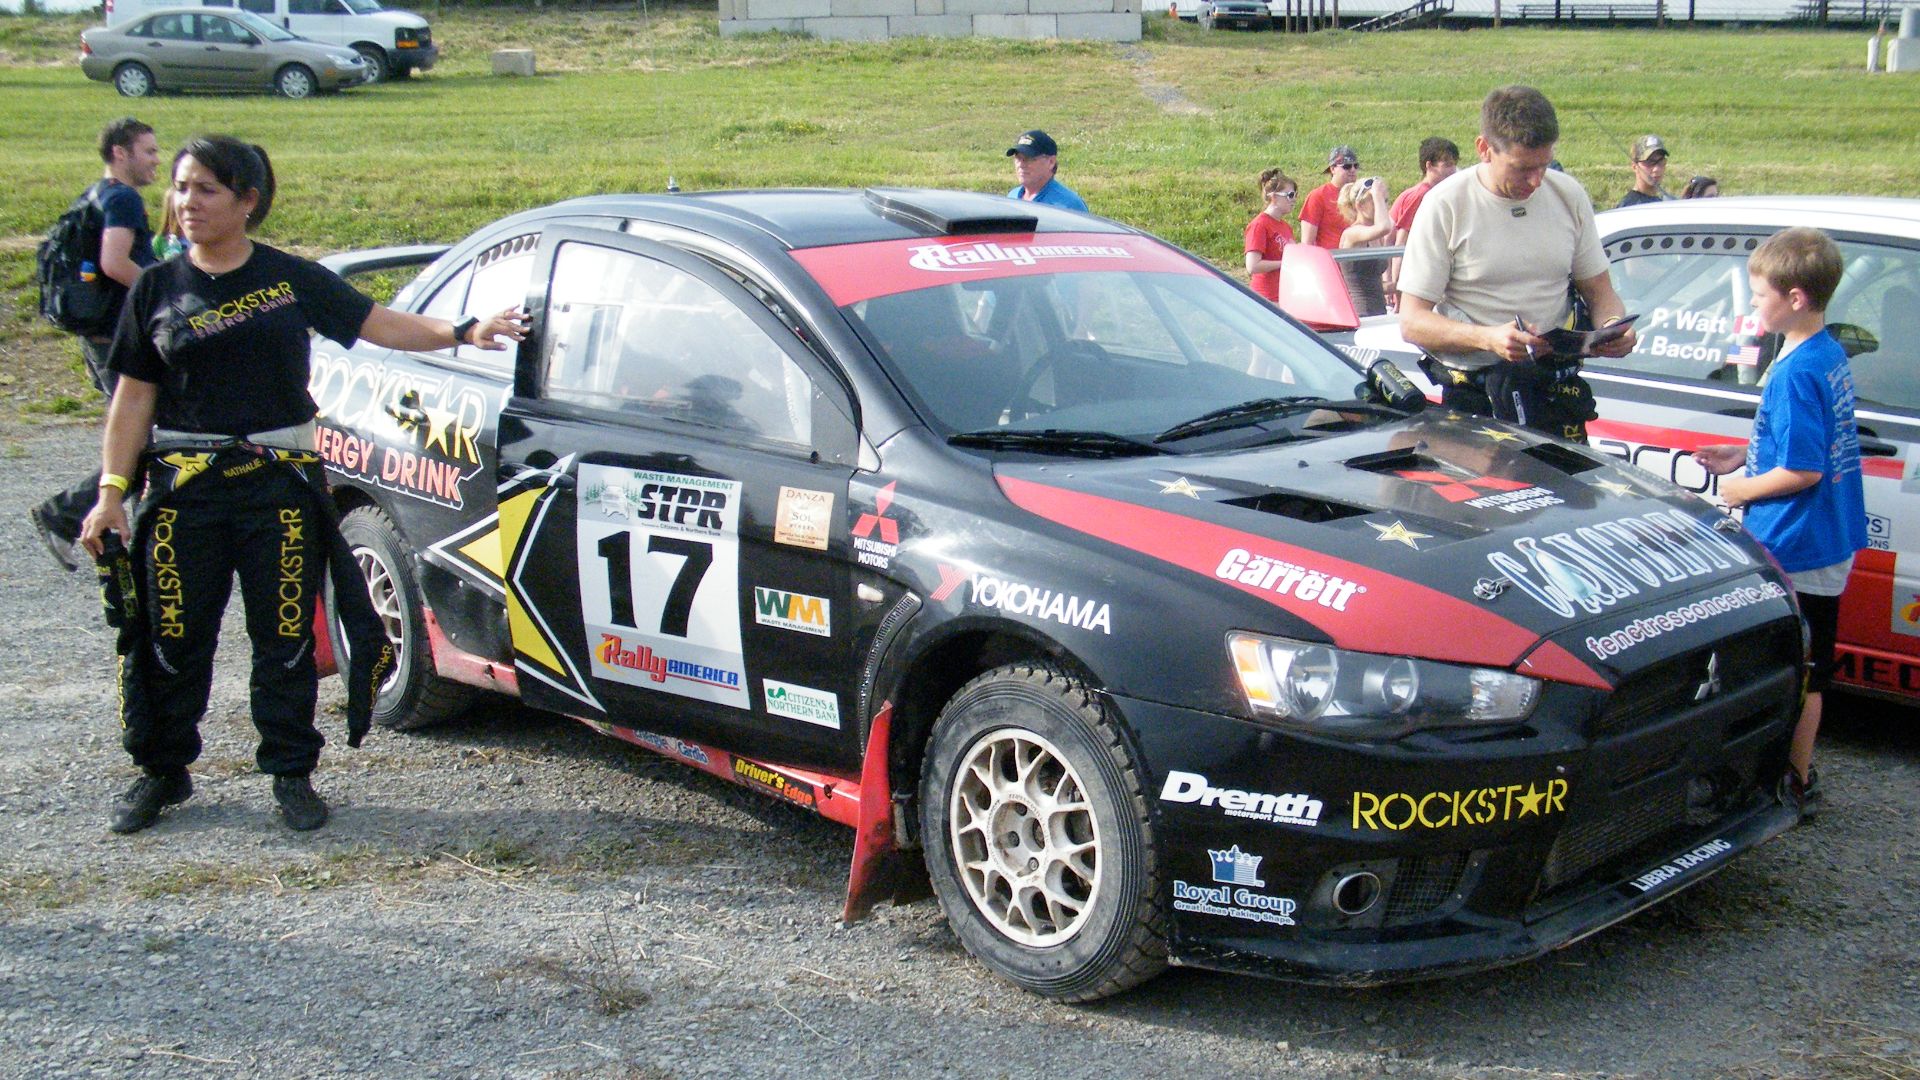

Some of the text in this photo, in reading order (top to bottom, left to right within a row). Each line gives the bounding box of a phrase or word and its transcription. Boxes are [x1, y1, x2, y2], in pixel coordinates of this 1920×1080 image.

[908, 242, 1037, 268] Rally
[188, 281, 293, 332] ROCKSTAR
[1650, 307, 1727, 334] P. Watt
[1650, 335, 1721, 362] Bacon
[314, 425, 374, 474] NERGY
[382, 447, 461, 503] DRINK
[634, 471, 734, 491] WASTE MANAGEMENT
[638, 483, 727, 530] STPR
[786, 489, 825, 503] DANZA
[1464, 486, 1555, 509] MITSUBISHI
[1499, 495, 1566, 514] MOTORS
[792, 511, 814, 524] SOL
[853, 537, 898, 557] MITSUBISHI
[857, 552, 889, 570] MOTORS
[1487, 508, 1750, 618] CONCERTO
[153, 507, 184, 638] ROCKSTAR
[278, 507, 304, 638] ROCKSTAR
[598, 530, 714, 639] 17
[1215, 548, 1357, 612] Garrett
[756, 588, 825, 626] WM
[971, 573, 1112, 635] YOKOHAMA
[761, 618, 826, 635] WASTE MANAGEMENT
[599, 633, 739, 686] Rally AMERICA
[767, 698, 838, 723] NORTHERN BANK
[787, 692, 835, 711] CITIZENS &
[735, 758, 785, 789] Driver's
[1159, 770, 1324, 820] Drenth
[1352, 778, 1568, 831] ROCKSTAR
[1224, 808, 1317, 827] motorsport gearboxes
[1629, 838, 1732, 892] LIBRA RACING
[1173, 880, 1296, 917] Royal Group
[1174, 900, 1295, 926] Great Ideas Taking Shape.
